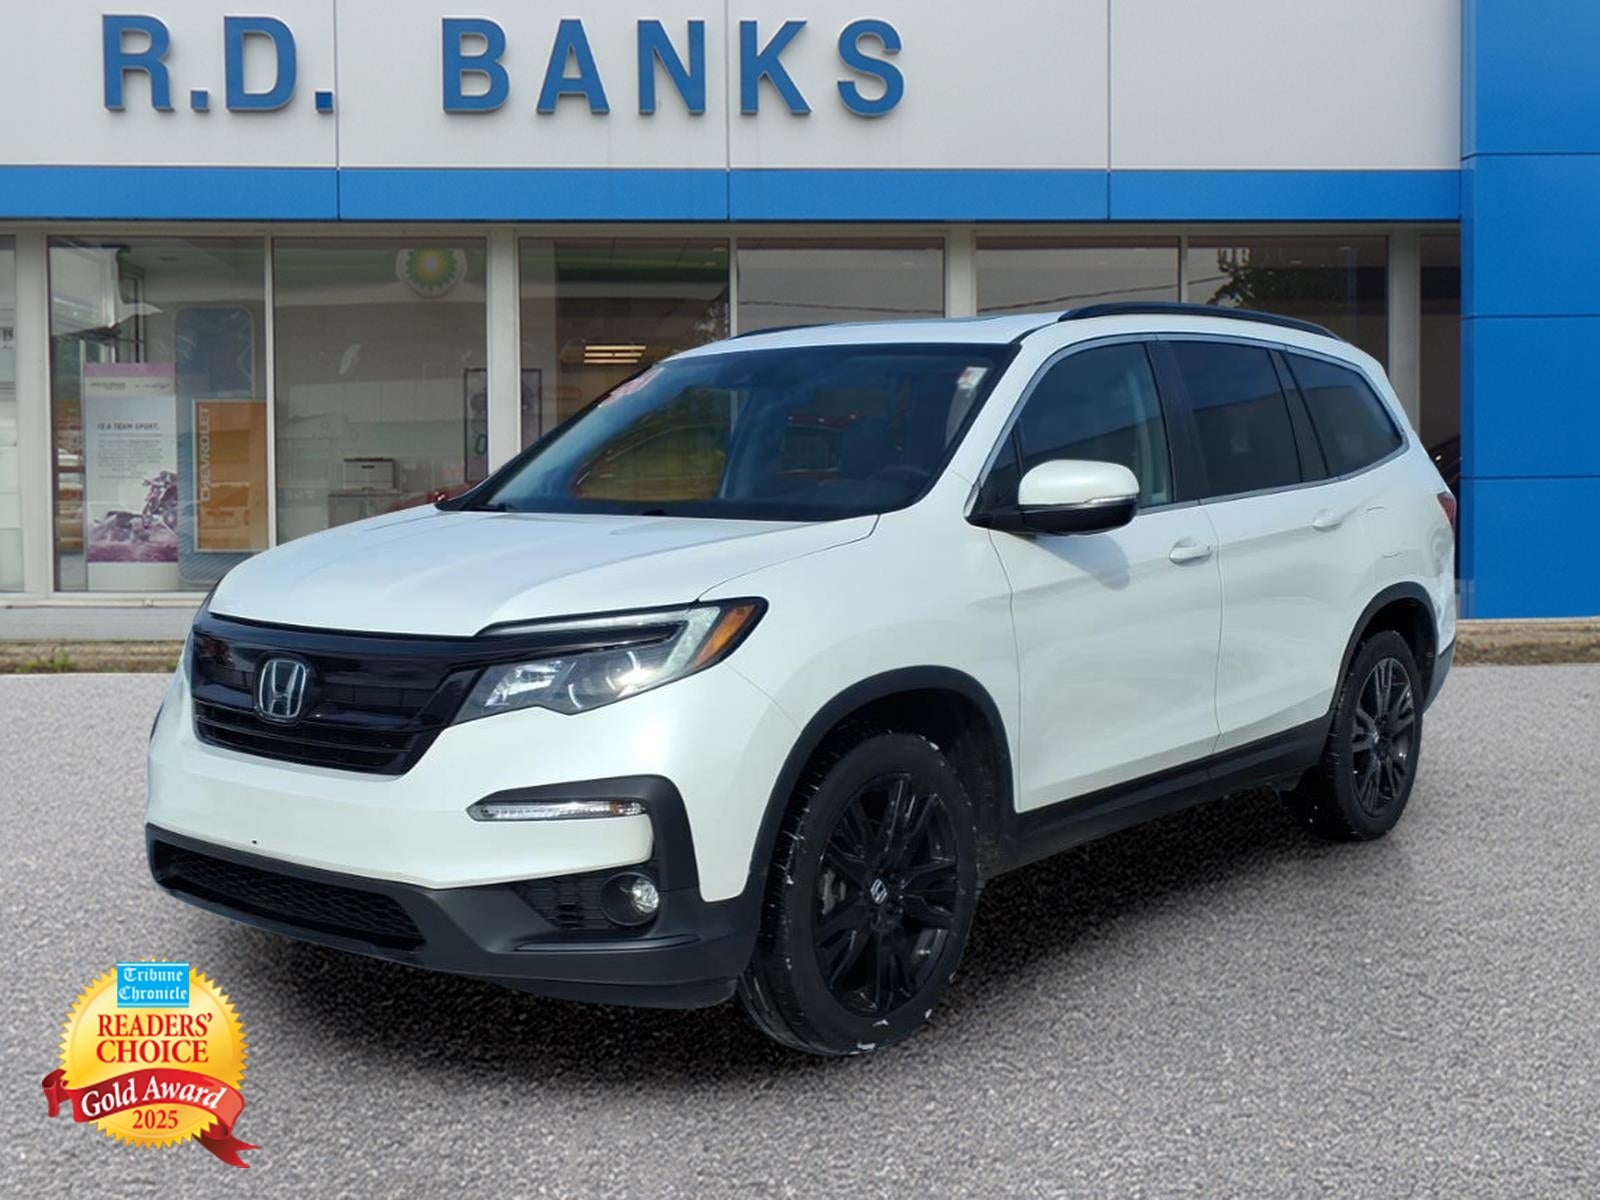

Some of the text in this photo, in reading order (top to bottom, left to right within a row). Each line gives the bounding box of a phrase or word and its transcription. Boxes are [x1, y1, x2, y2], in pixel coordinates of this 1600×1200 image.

[102, 14, 906, 117] R.D. BANKS
[114, 422, 133, 430] TEAM
[200, 407, 210, 501] CHEVROLET
